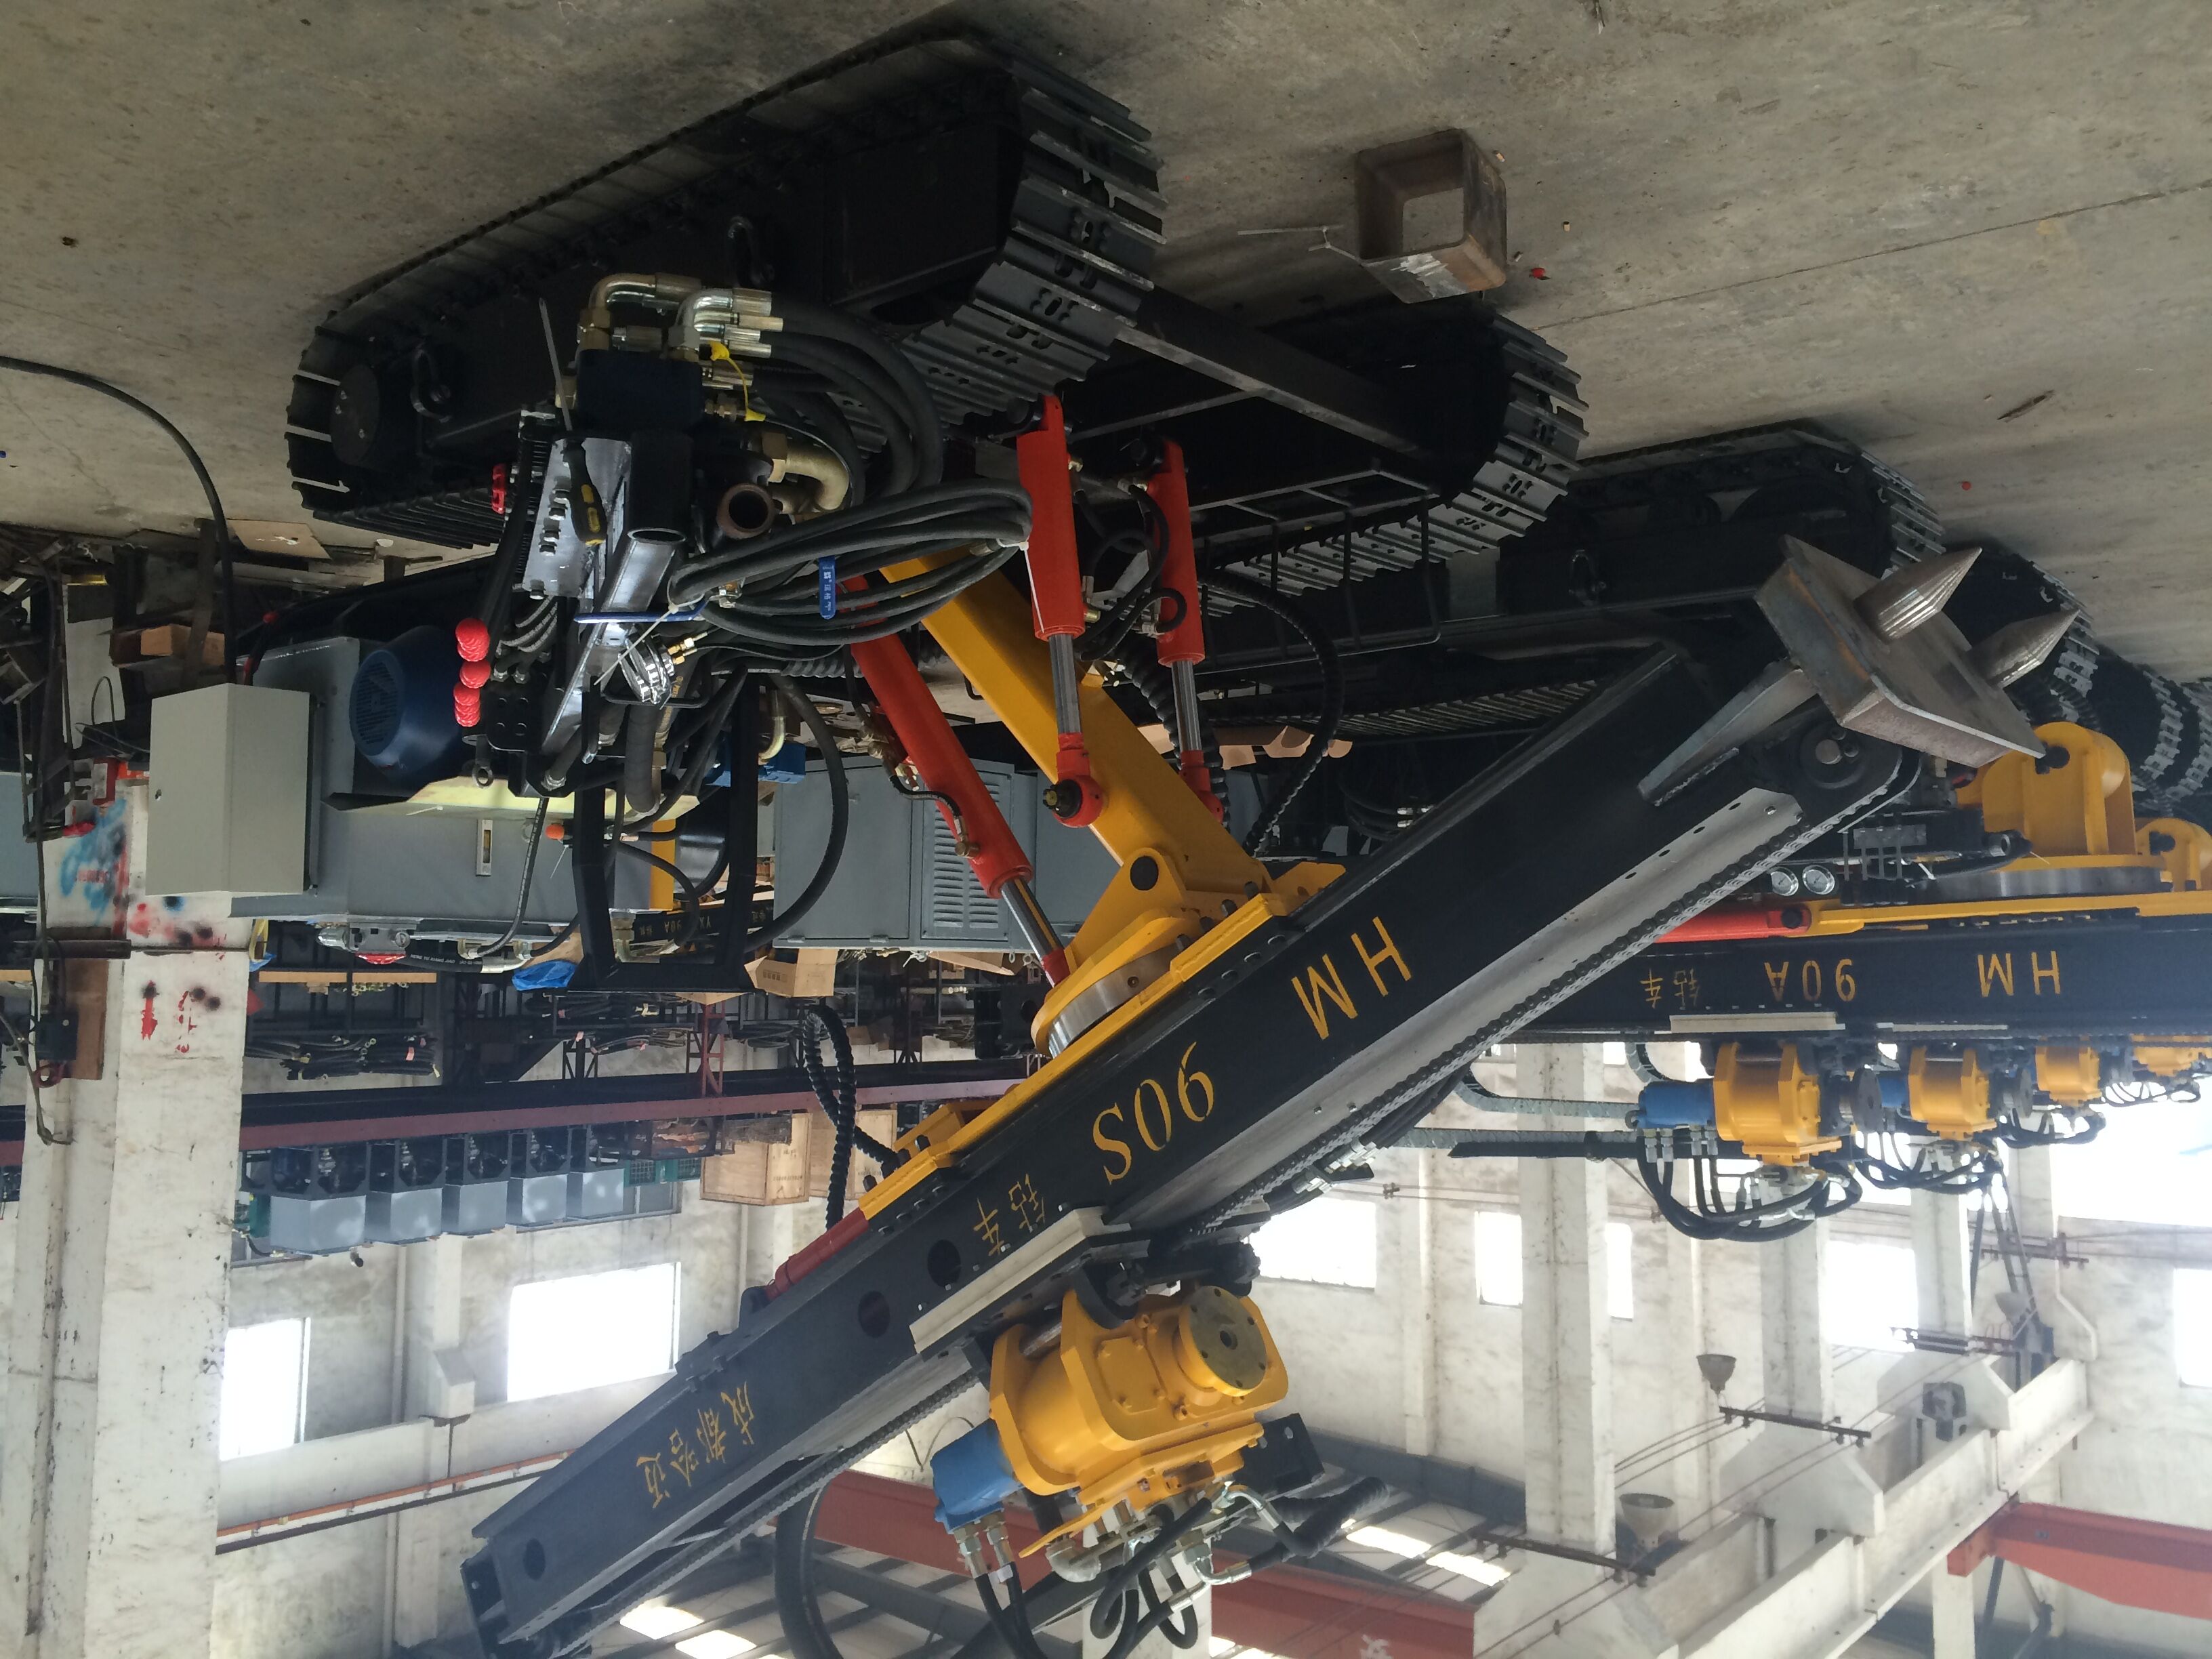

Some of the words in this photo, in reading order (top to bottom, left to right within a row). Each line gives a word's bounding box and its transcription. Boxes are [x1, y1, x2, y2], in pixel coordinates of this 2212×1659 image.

[1291, 916, 1411, 1040] HM
[1640, 967, 1699, 1010] 钻车
[1764, 958, 1856, 1002] 90A
[1978, 950, 2061, 998] HM
[1092, 1042, 1214, 1185] 90S
[973, 1174, 1045, 1256] 钻车
[636, 1381, 754, 1509] 成都哈迈
